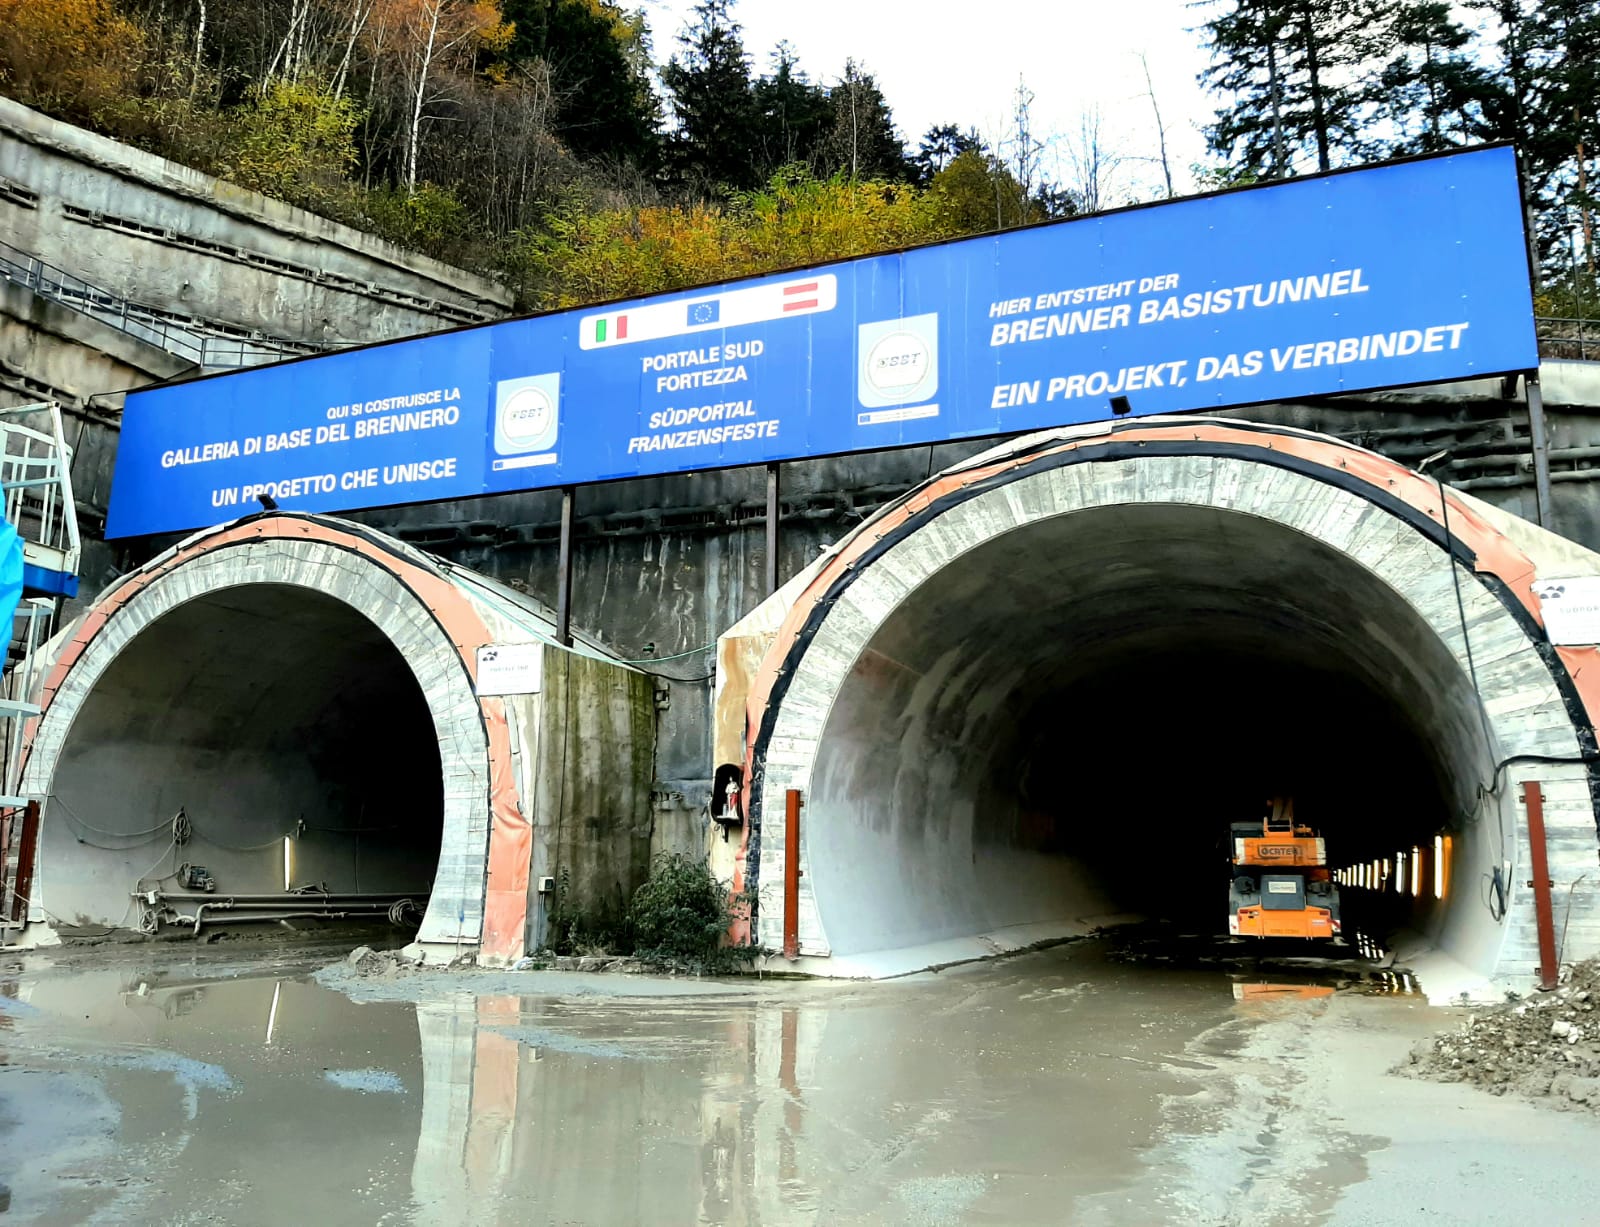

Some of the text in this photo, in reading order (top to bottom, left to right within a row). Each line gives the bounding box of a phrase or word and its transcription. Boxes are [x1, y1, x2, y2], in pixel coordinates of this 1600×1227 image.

[989, 272, 1180, 318] HIER ENTSTEHT DER
[990, 268, 1370, 347] BRENNER BASISTUNNEL
[642, 340, 764, 373] PORTALE SUD
[991, 322, 1469, 408] EIN PROJEKT, DAS VERBINDET
[656, 365, 748, 393] FORTEZZA
[326, 387, 461, 420] QUI SI COSTRUISCE LA
[649, 400, 755, 429] SÜDPORTAL
[161, 405, 460, 468] GALLERIA DI BASE DEL BRENNERO
[627, 420, 780, 454] FRANZENSFESTE
[212, 457, 457, 508] UN PROGETTO CHE UNISCE
